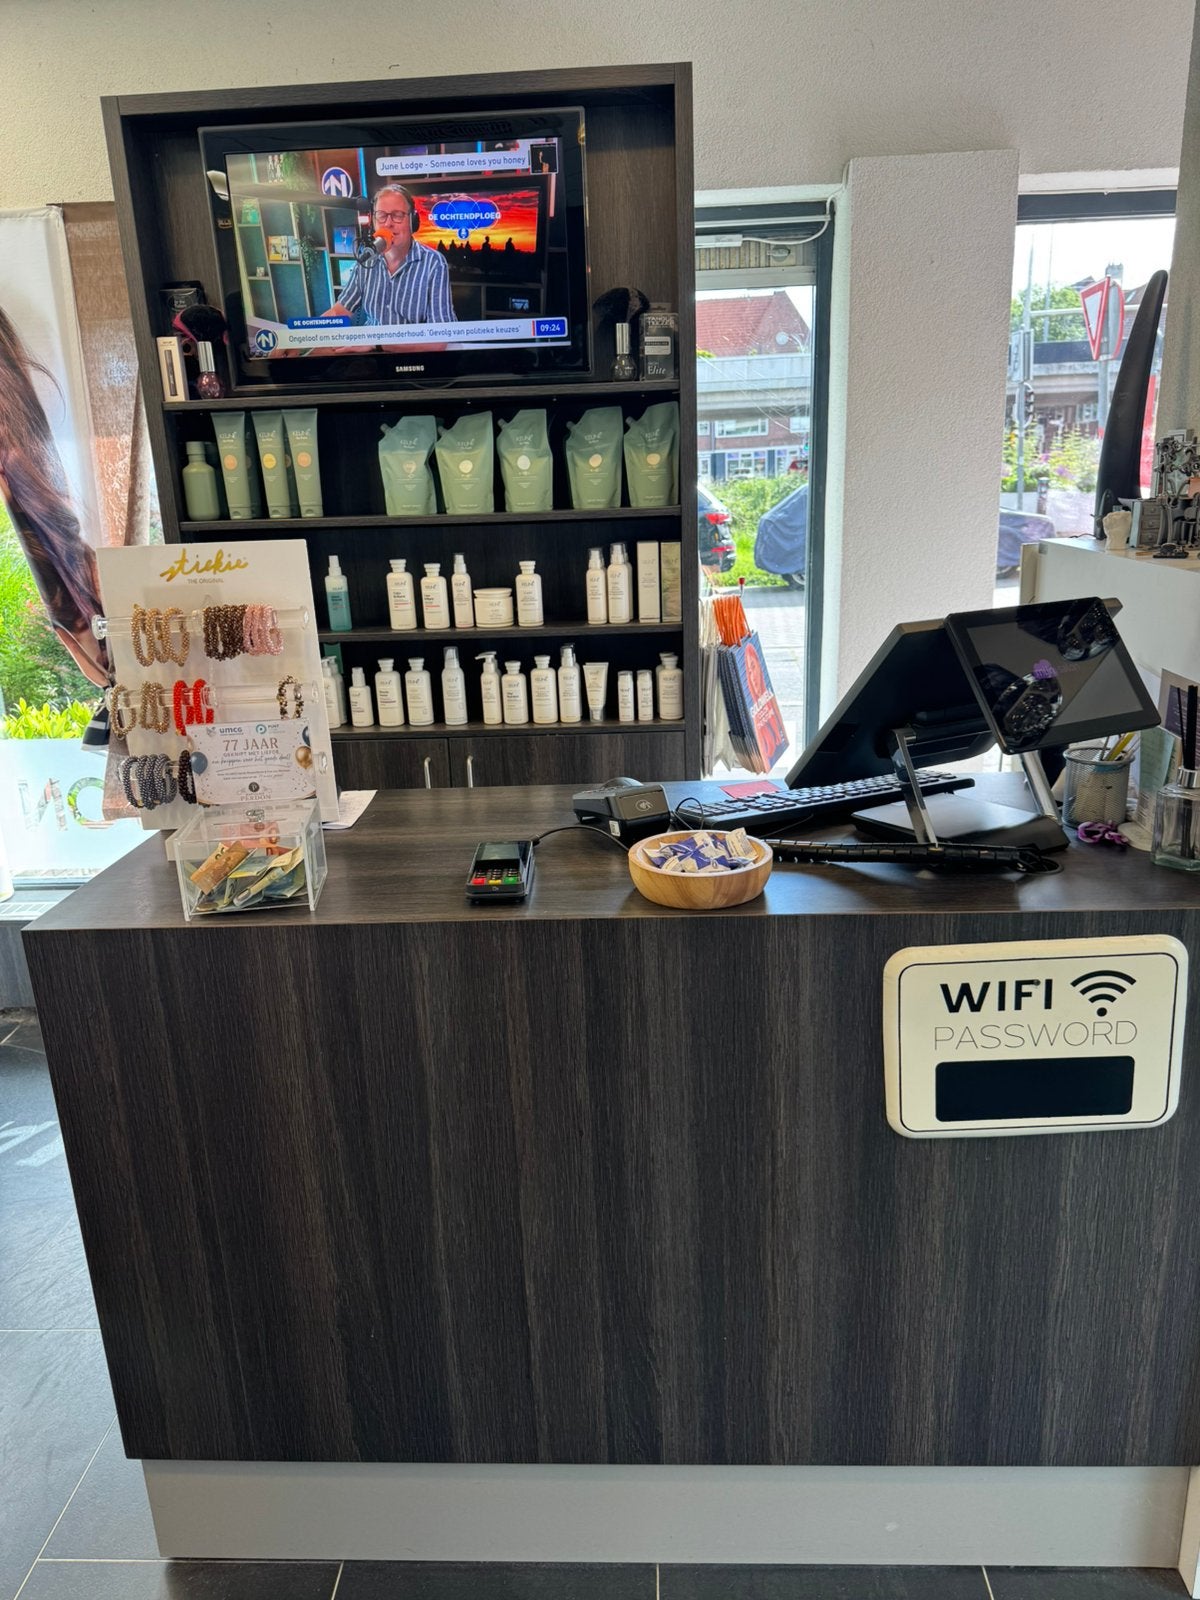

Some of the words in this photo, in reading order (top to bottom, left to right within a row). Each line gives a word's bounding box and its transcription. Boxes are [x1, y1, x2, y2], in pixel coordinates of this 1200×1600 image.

[381, 162, 399, 171] June
[400, 160, 424, 170] Lodge
[430, 159, 465, 168] Someone
[466, 157, 487, 166] loves
[488, 158, 502, 167] you
[503, 156, 526, 165] honey
[428, 213, 438, 221] DE
[439, 211, 502, 221] OCHTENDPLOEG
[288, 333, 318, 343] Ongeloof
[331, 332, 366, 342] schrappen
[452, 328, 465, 336] van
[466, 326, 495, 336] politieke
[540, 323, 561, 332] 09:24
[223, 739, 238, 751] 77
[243, 737, 279, 751] JAAR
[939, 978, 1053, 1014] WIFI
[933, 1019, 1139, 1051] PASSWORD
